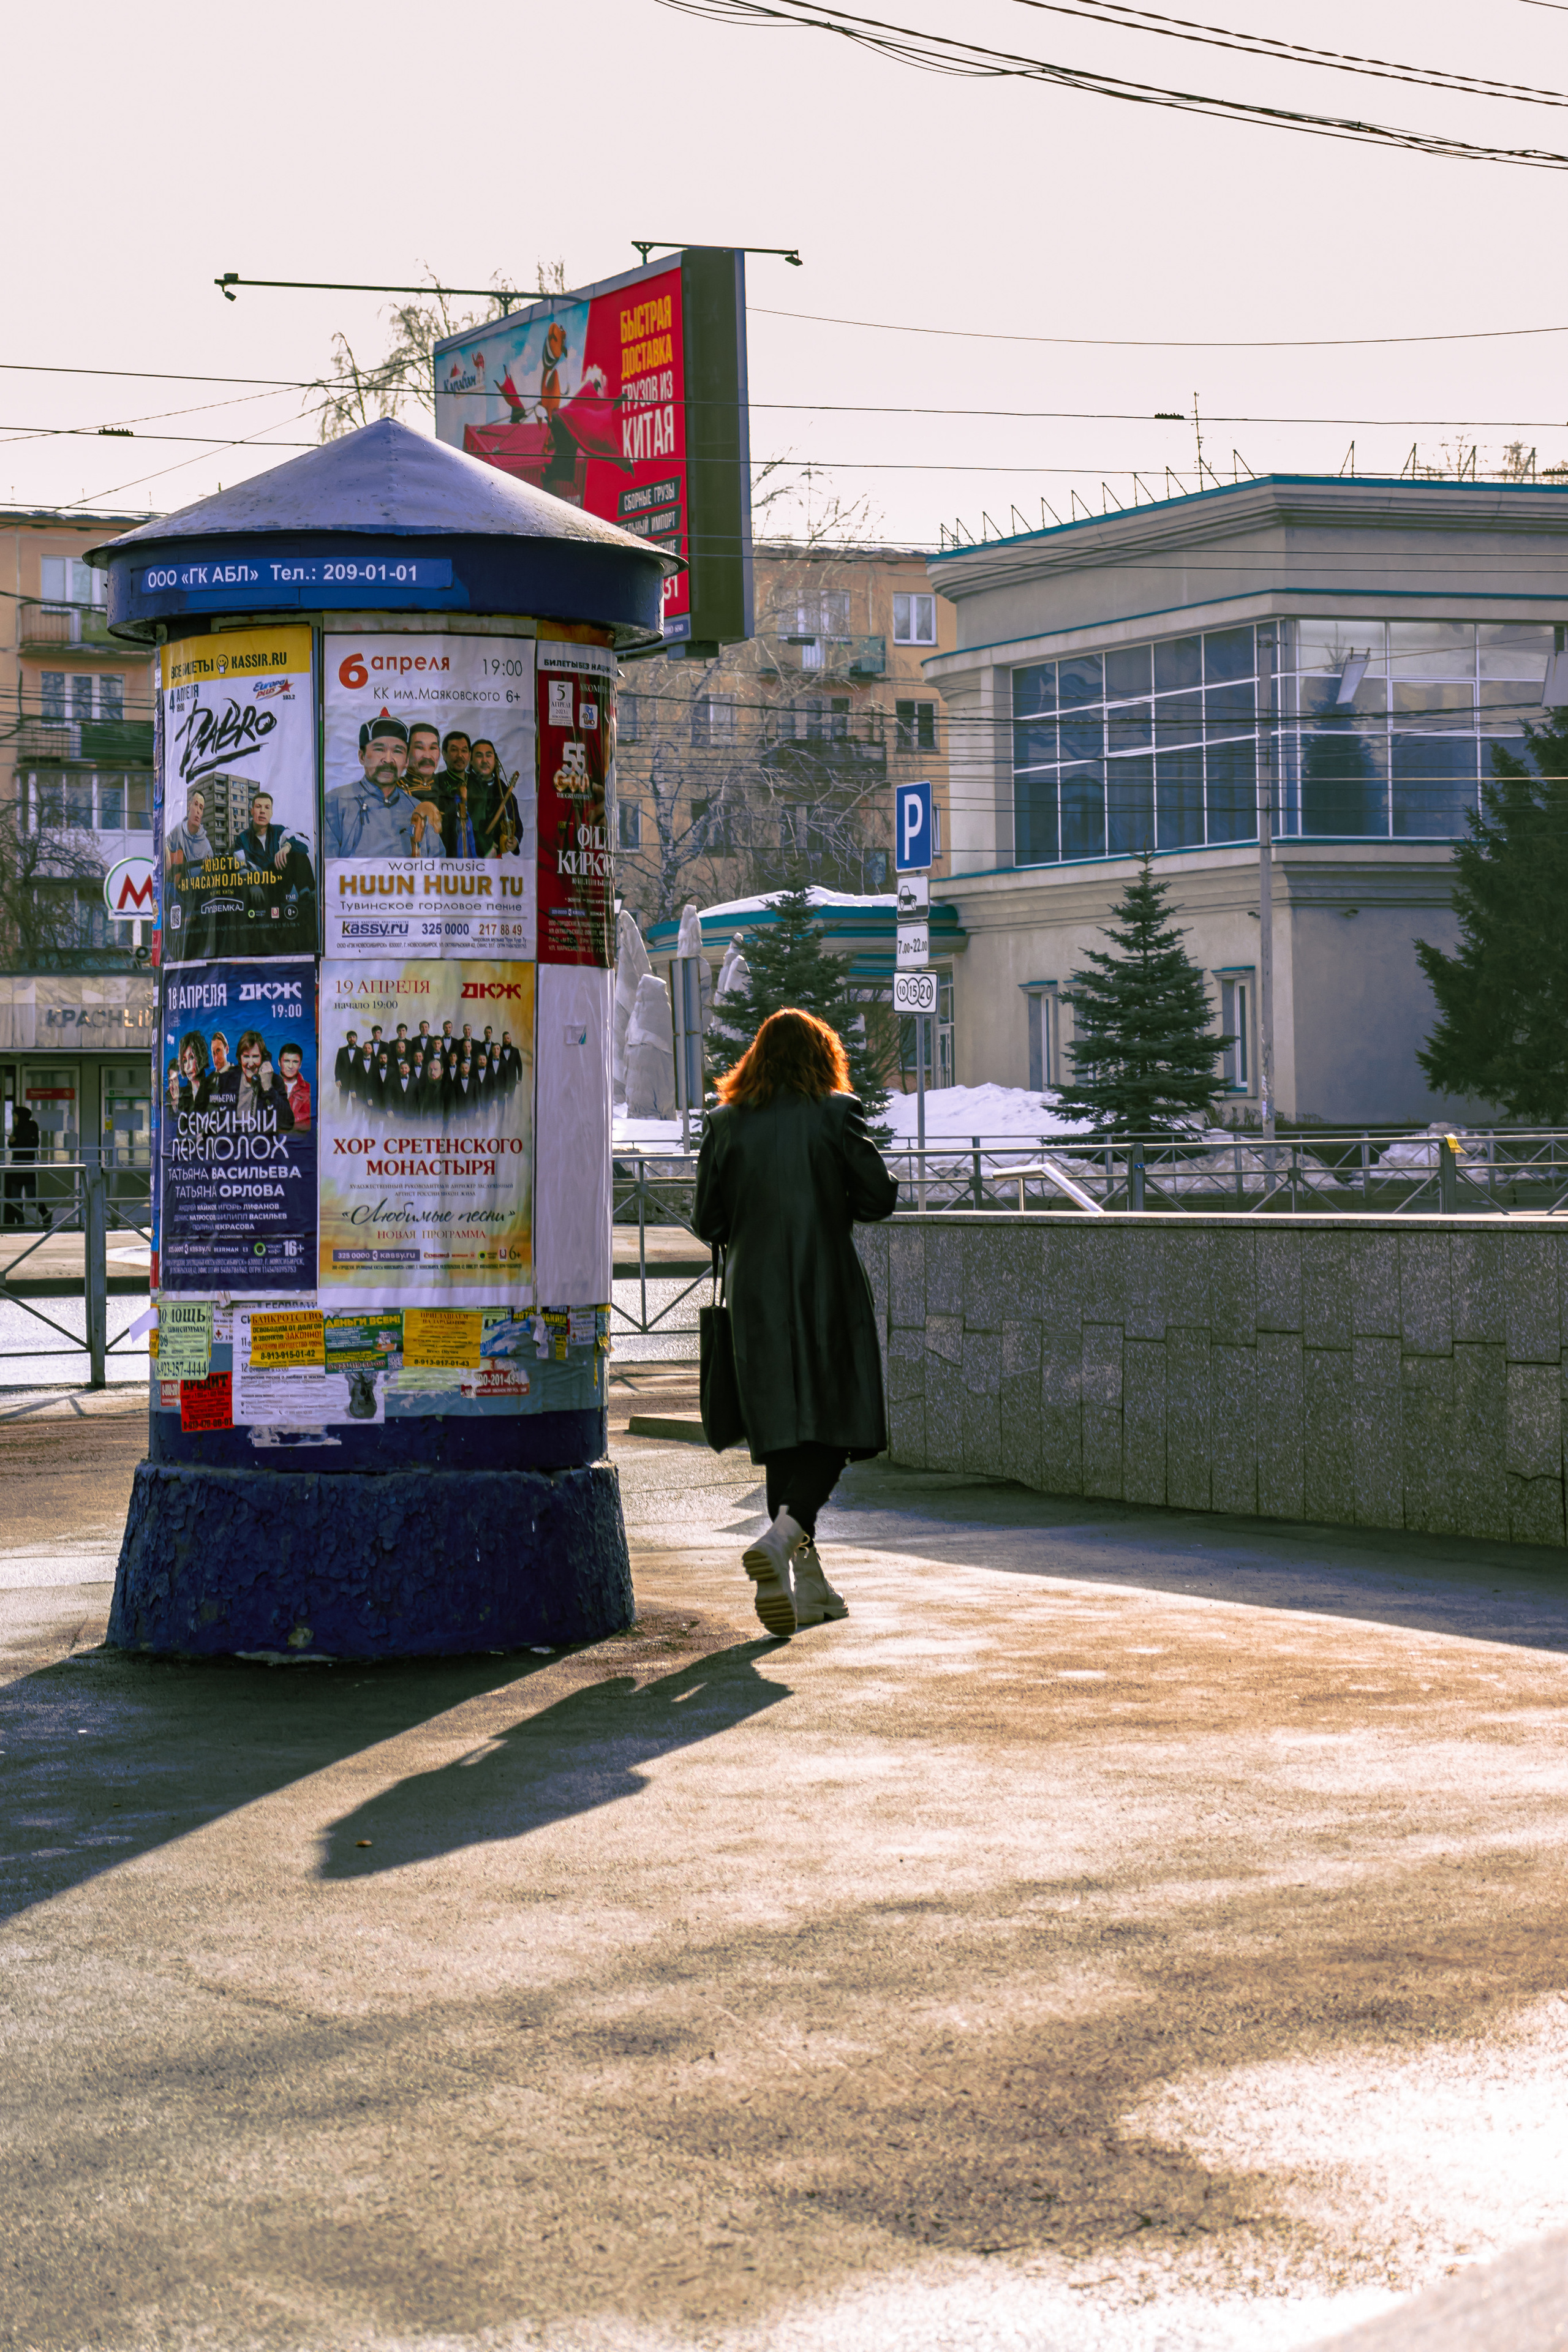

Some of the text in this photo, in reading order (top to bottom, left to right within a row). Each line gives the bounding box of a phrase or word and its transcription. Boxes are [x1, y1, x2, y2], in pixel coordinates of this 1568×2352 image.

[620, 295, 671, 344] БЫСТРАЯ
[621, 334, 673, 380] ДОСТАВКА
[622, 370, 673, 413] ГРУЗОВ ИЗ
[623, 405, 674, 464] КИТАЯ
[624, 483, 675, 511] СБОРНЫЕ ГРУЗЫ
[651, 511, 676, 532] ИМПОРТ
[148, 564, 417, 589] ООО «ГК АБЛ» Тел.: 209-01-01
[171, 665, 181, 679] ВСЕ
[231, 652, 287, 669] KASSIR.RU
[339, 653, 522, 690] 6 апреля 19:00
[544, 658, 578, 668] БИЛЕТЫ
[374, 687, 388, 699] КК
[506, 690, 521, 703] 6+
[556, 684, 565, 701] 5
[170, 690, 175, 713] 4
[175, 698, 277, 778] DABRO
[562, 742, 585, 775] 55
[904, 793, 923, 861] P
[388, 860, 485, 872] world music
[190, 876, 215, 890] ЧАСАХ
[339, 875, 523, 896] HUUN HUUR TU
[341, 901, 522, 912] Тувинское горловое пение
[342, 921, 522, 937] kassy.ru 325 0000 217 88 49
[899, 938, 927, 954] 7.00-22.00
[335, 980, 353, 995] 19
[358, 980, 431, 994] АПРЕЛЯ
[899, 984, 931, 1000] 10 15 20
[168, 987, 178, 1010] 18
[179, 983, 227, 1009] АПРЕЛЯ
[334, 1000, 398, 1009] начало 19:00
[271, 1004, 301, 1017] 19:00
[178, 1105, 276, 1136] СЕМЕЙНЫЙ
[172, 1136, 288, 1161] ПЕРЕПОЛОХ
[333, 1137, 522, 1155] ХОР СРЕТЕНСКОГО
[168, 1166, 301, 1181] ТАТЬЯНА ВАСИЛЬЕВА
[366, 1159, 495, 1176] МОНАСТЫРЯ
[175, 1184, 285, 1198] ТАТЬЯНА ОРЛОВА
[342, 1197, 516, 1225] «Любимые песни»
[377, 1230, 486, 1239] НОВАЯ ПРОГРАММА
[283, 1240, 304, 1256] 16+
[509, 1245, 521, 1261] 6+
[252, 1312, 323, 1325] БАНКРОТСТВО
[325, 1315, 401, 1329] ДЕНЬГИ ВСЕМ!
[285, 1331, 322, 1340] ЗАКОННО!
[261, 1349, 315, 1360] 8-913-915-01-42
